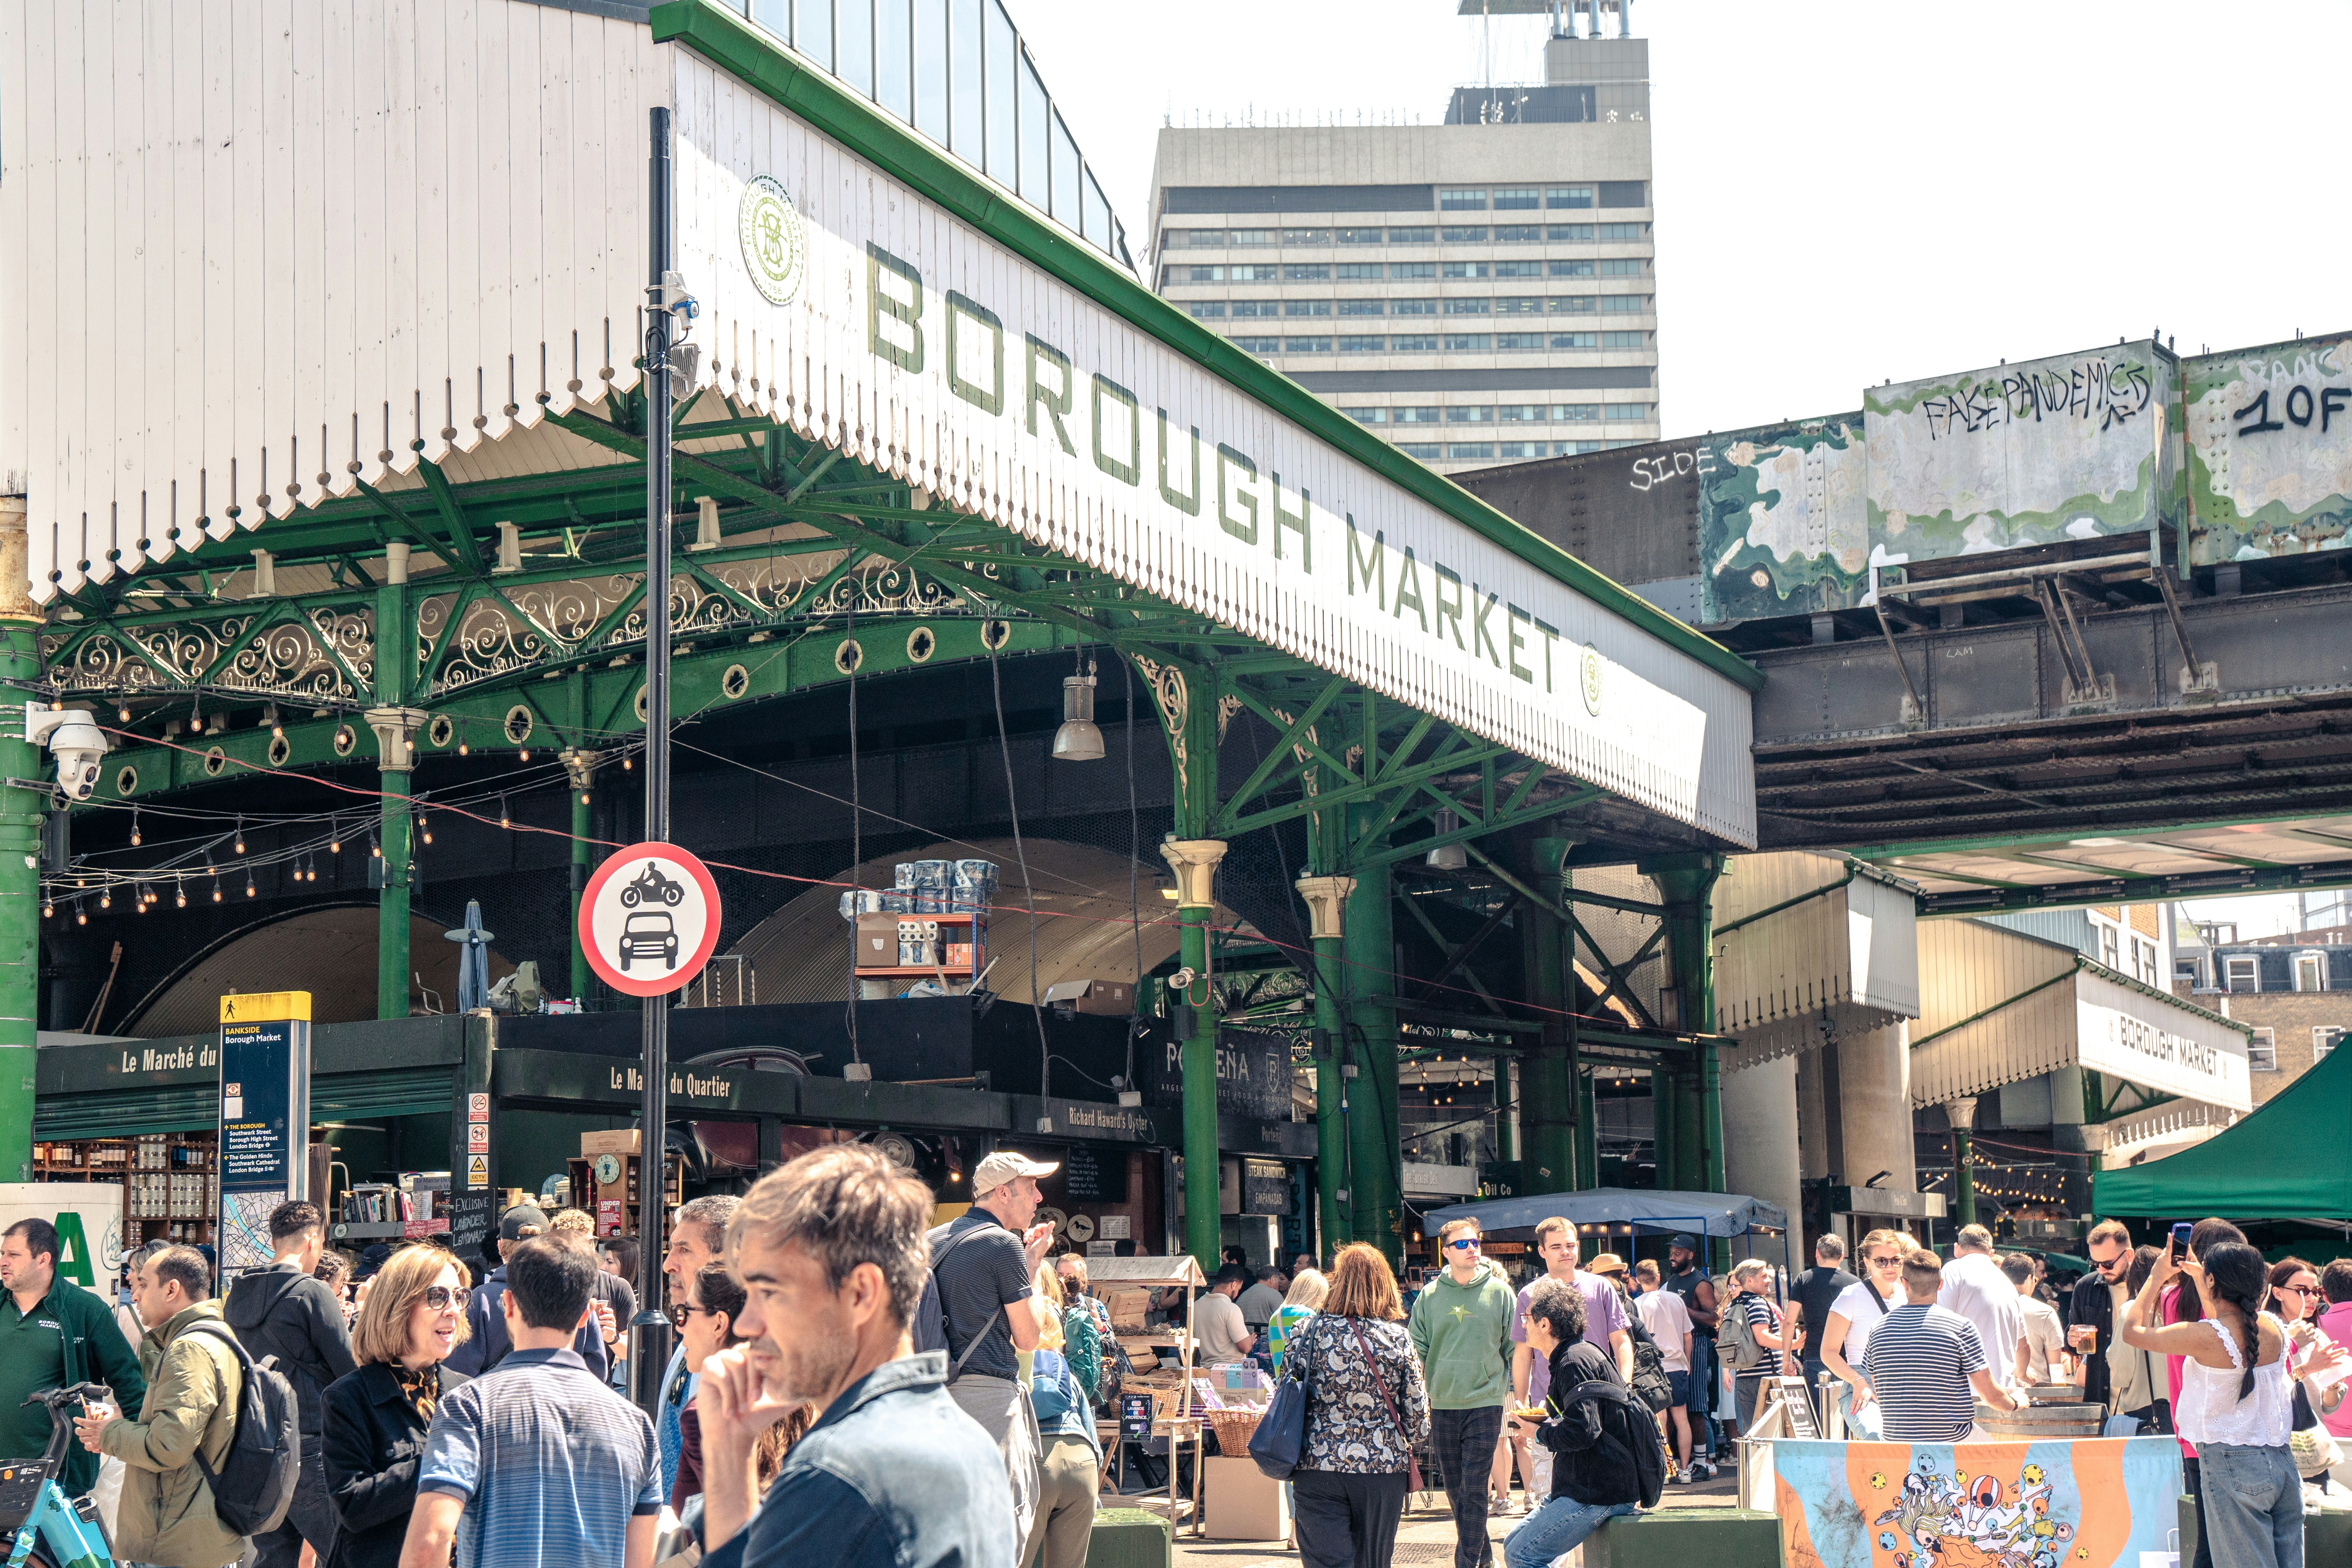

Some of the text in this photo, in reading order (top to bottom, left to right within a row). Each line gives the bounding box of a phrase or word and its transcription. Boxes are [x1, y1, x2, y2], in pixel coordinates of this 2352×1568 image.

[744, 183, 800, 270] BOROUGH MARKET
[764, 279, 783, 294] 1756
[1922, 385, 1999, 440] FAKE
[866, 239, 1560, 694] BOROUGH MARKET
[1630, 446, 1716, 491] SIDE
[225, 1026, 260, 1035] BANKSIDE
[225, 1035, 254, 1044] Borough
[2120, 1016, 2217, 1076] BOROUGH MARKET
[122, 1044, 216, 1073] Le Marché du
[611, 1067, 623, 1090] Le
[670, 1072, 682, 1094] du
[687, 1073, 730, 1099] Quartier
[1234, 1091, 1250, 1099] FOOD
[1069, 1107, 1095, 1126] Richard
[1097, 1110, 1126, 1129] Haward's
[1248, 1165, 1286, 1179] STEAK SANDWICH
[1255, 1192, 1282, 1205] EMPANADAS
[1485, 1183, 1497, 1196] Oil
[1500, 1183, 1512, 1195] Co
[455, 1197, 489, 1212] EXCLUSIVE
